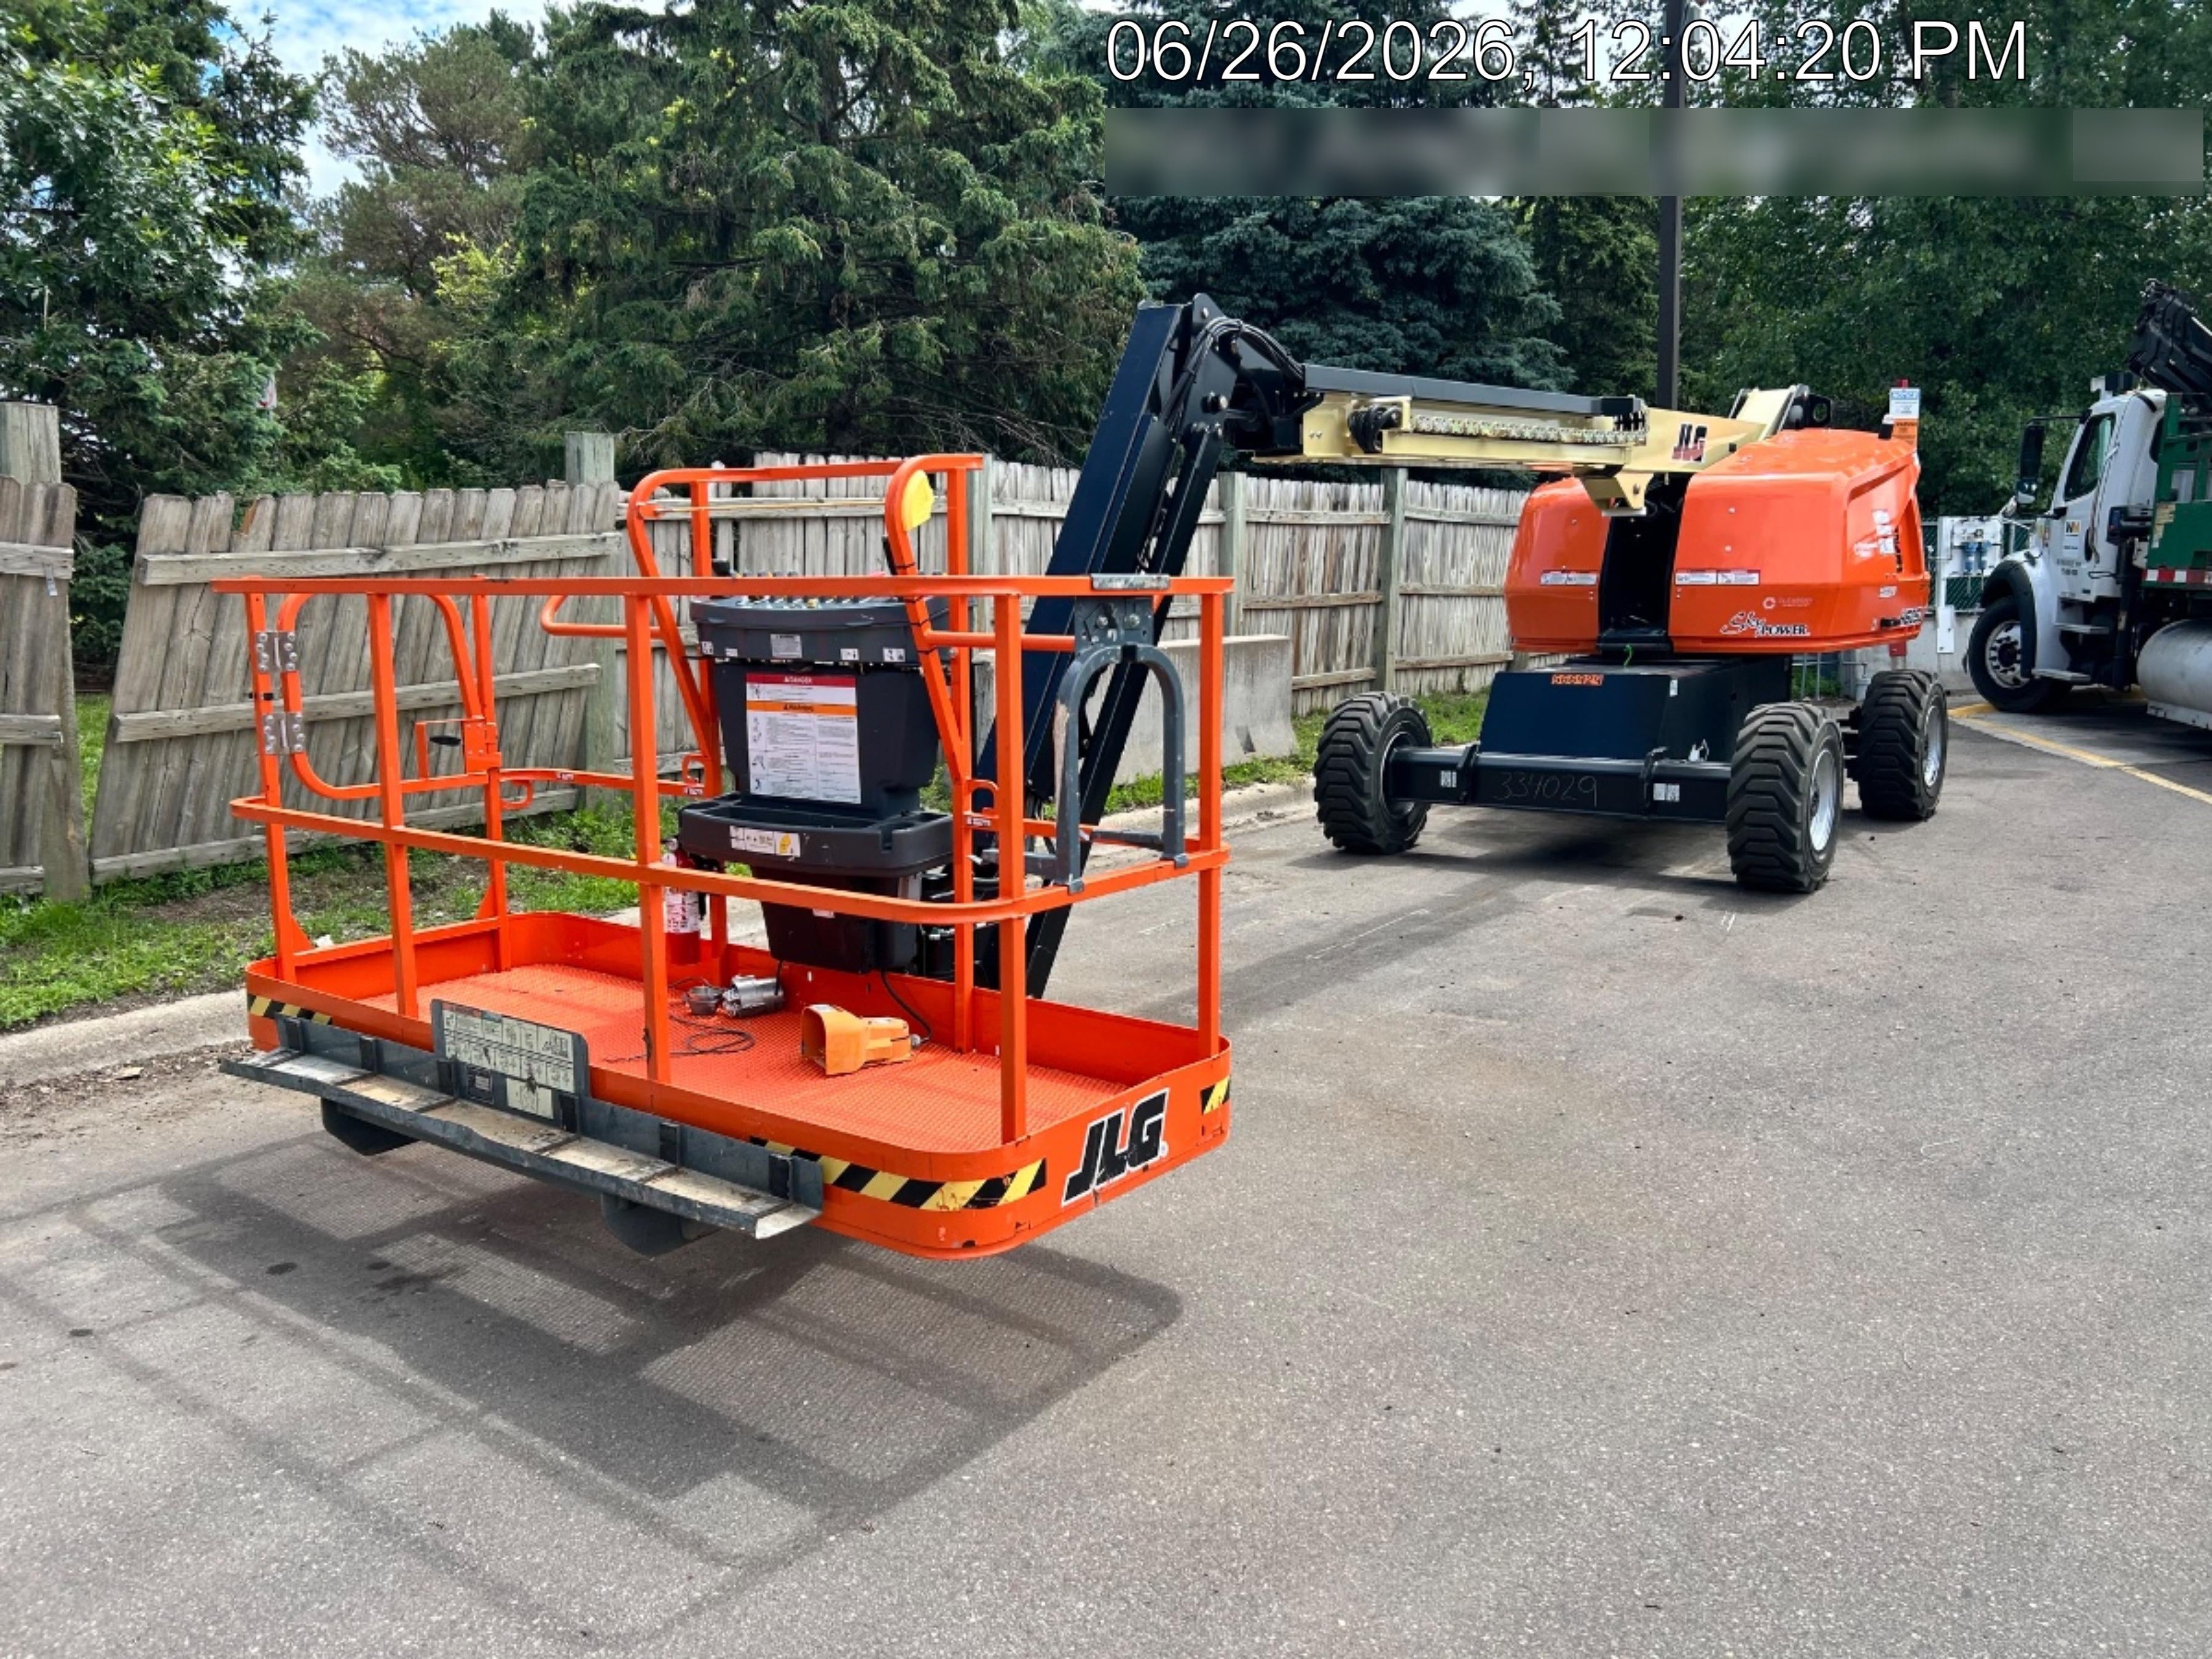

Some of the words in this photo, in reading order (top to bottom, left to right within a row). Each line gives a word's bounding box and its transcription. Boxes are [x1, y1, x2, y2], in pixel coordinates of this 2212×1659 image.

[1671, 423, 1708, 463] JLG
[1761, 623, 1810, 636] POWER
[1062, 1088, 1169, 1208] JLG
